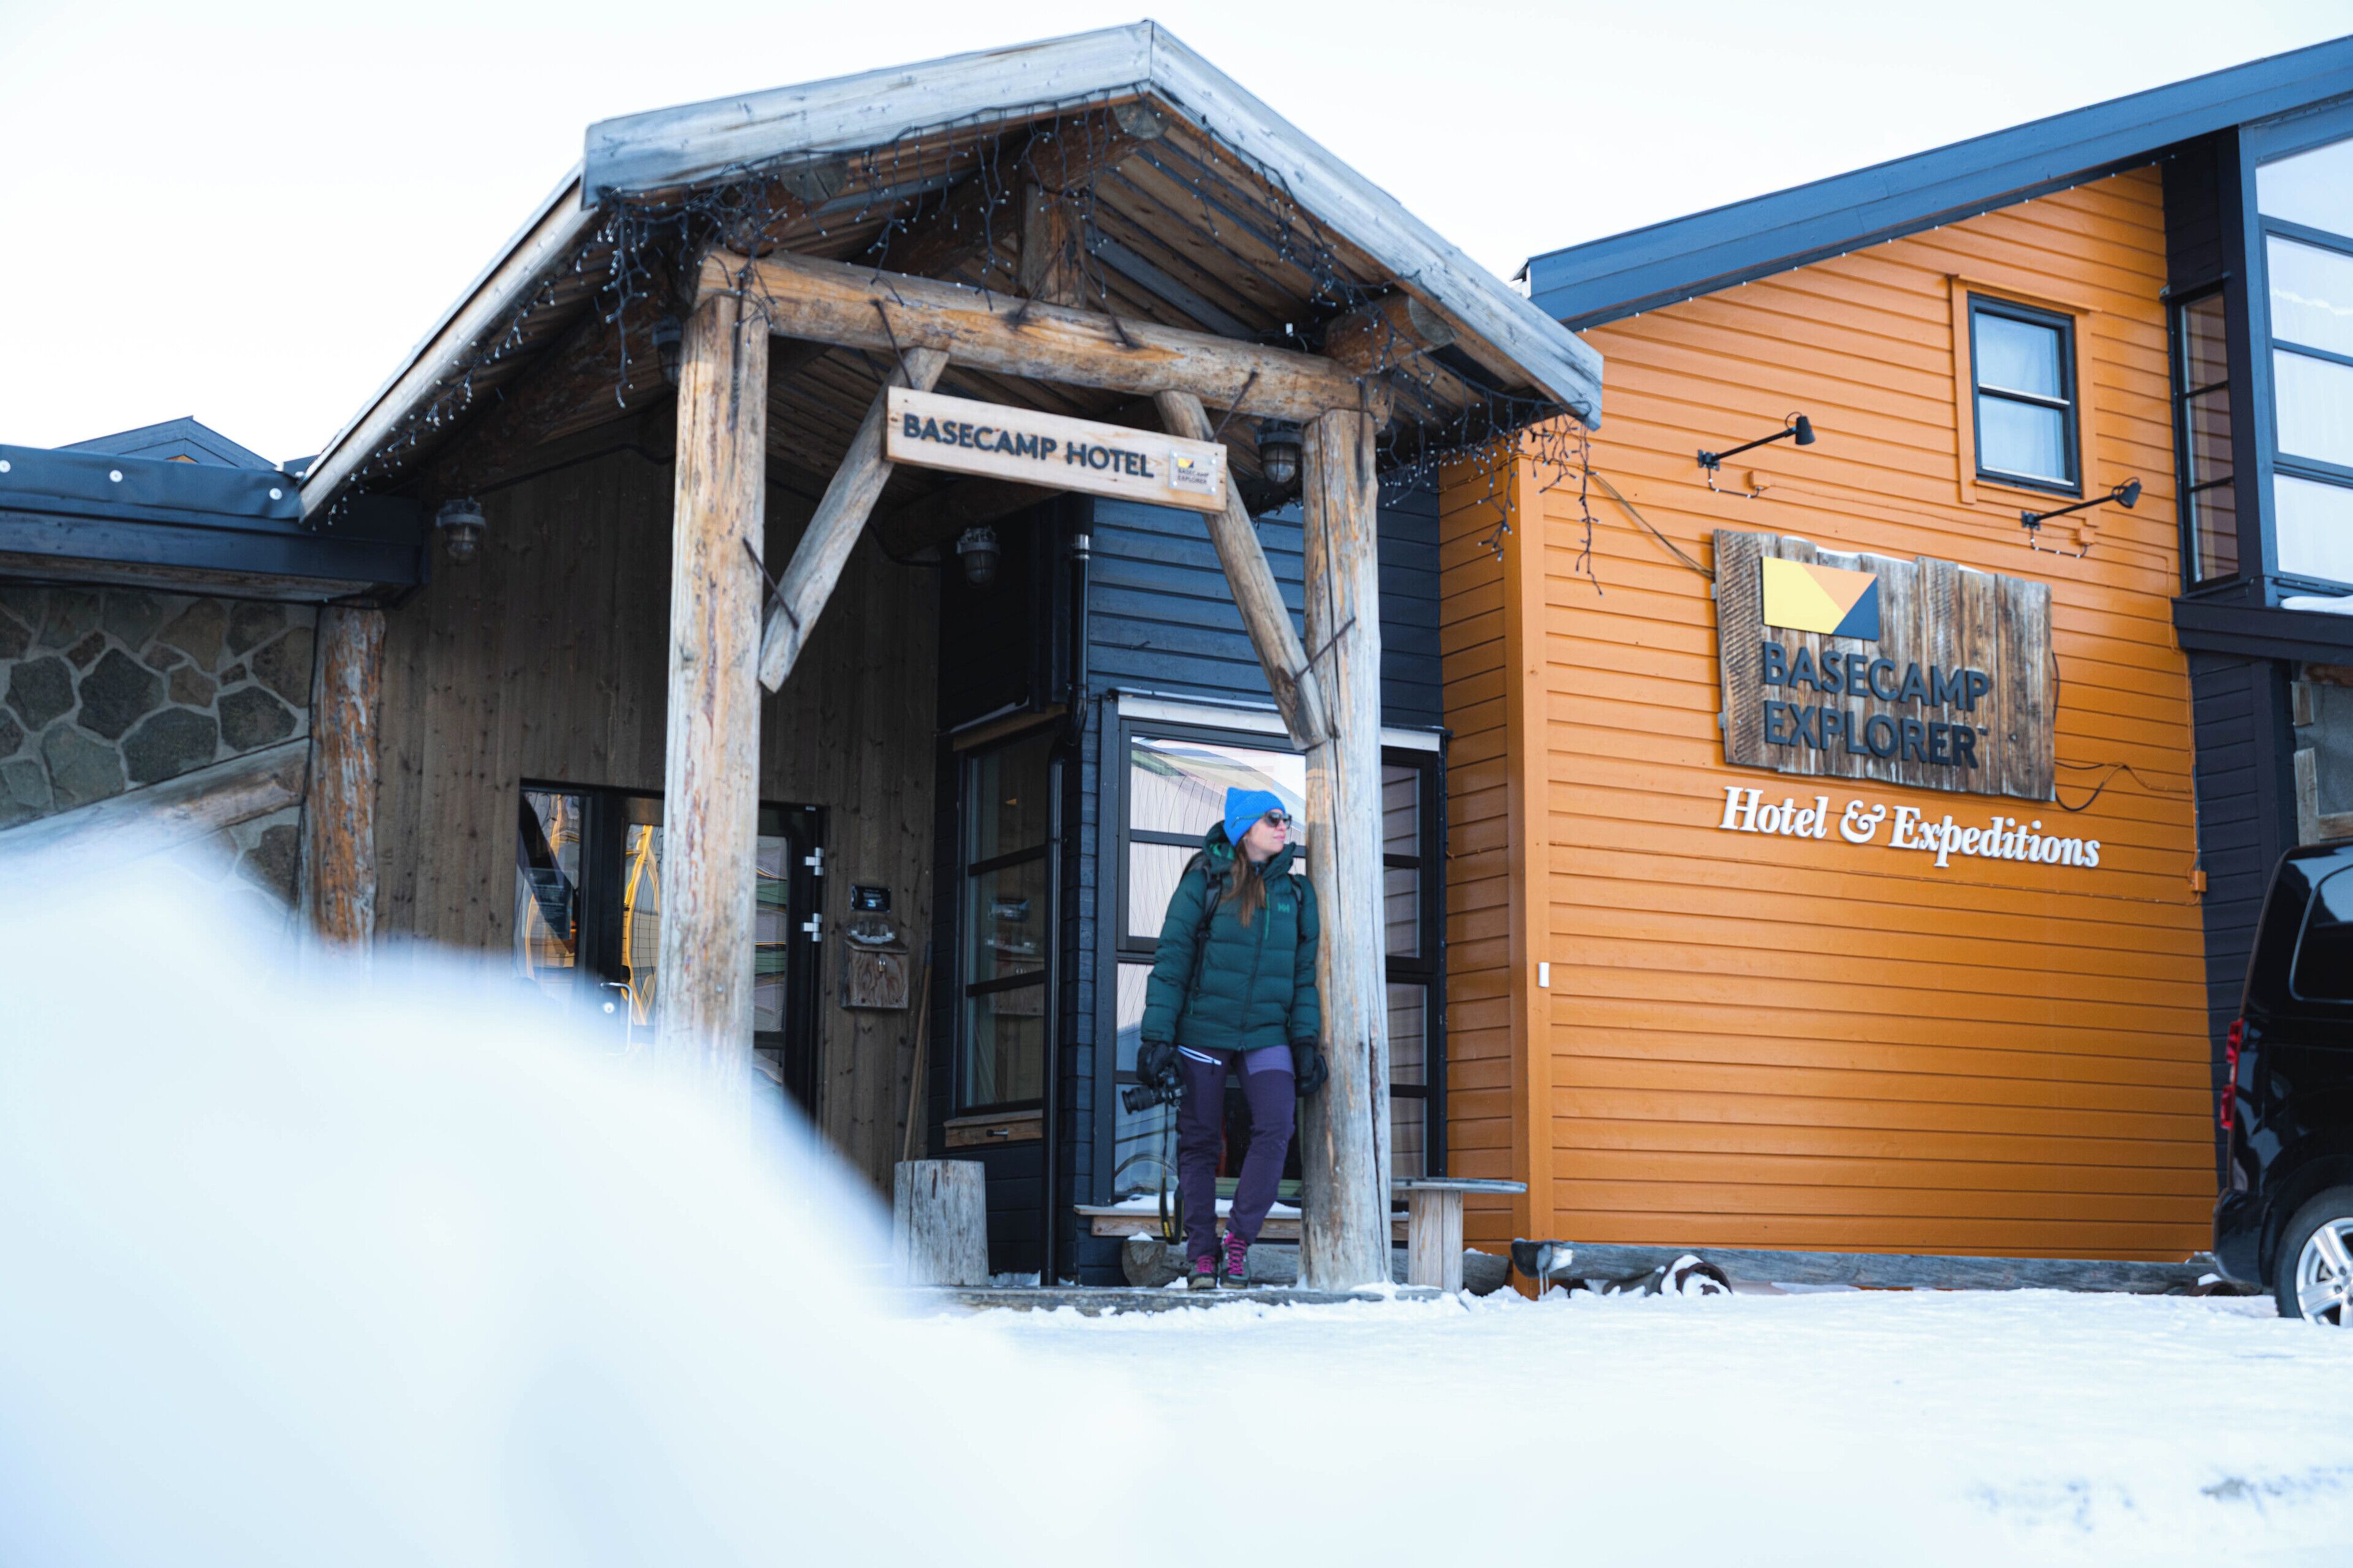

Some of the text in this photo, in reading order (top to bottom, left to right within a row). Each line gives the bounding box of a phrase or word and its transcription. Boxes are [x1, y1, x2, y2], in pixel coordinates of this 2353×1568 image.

[904, 413, 1154, 478] BASECAMP HOTEL
[1763, 642, 1989, 711] BASECAMP
[1765, 700, 1979, 769] EXPLORER
[1719, 787, 2101, 868] Hotel & Expeditions
